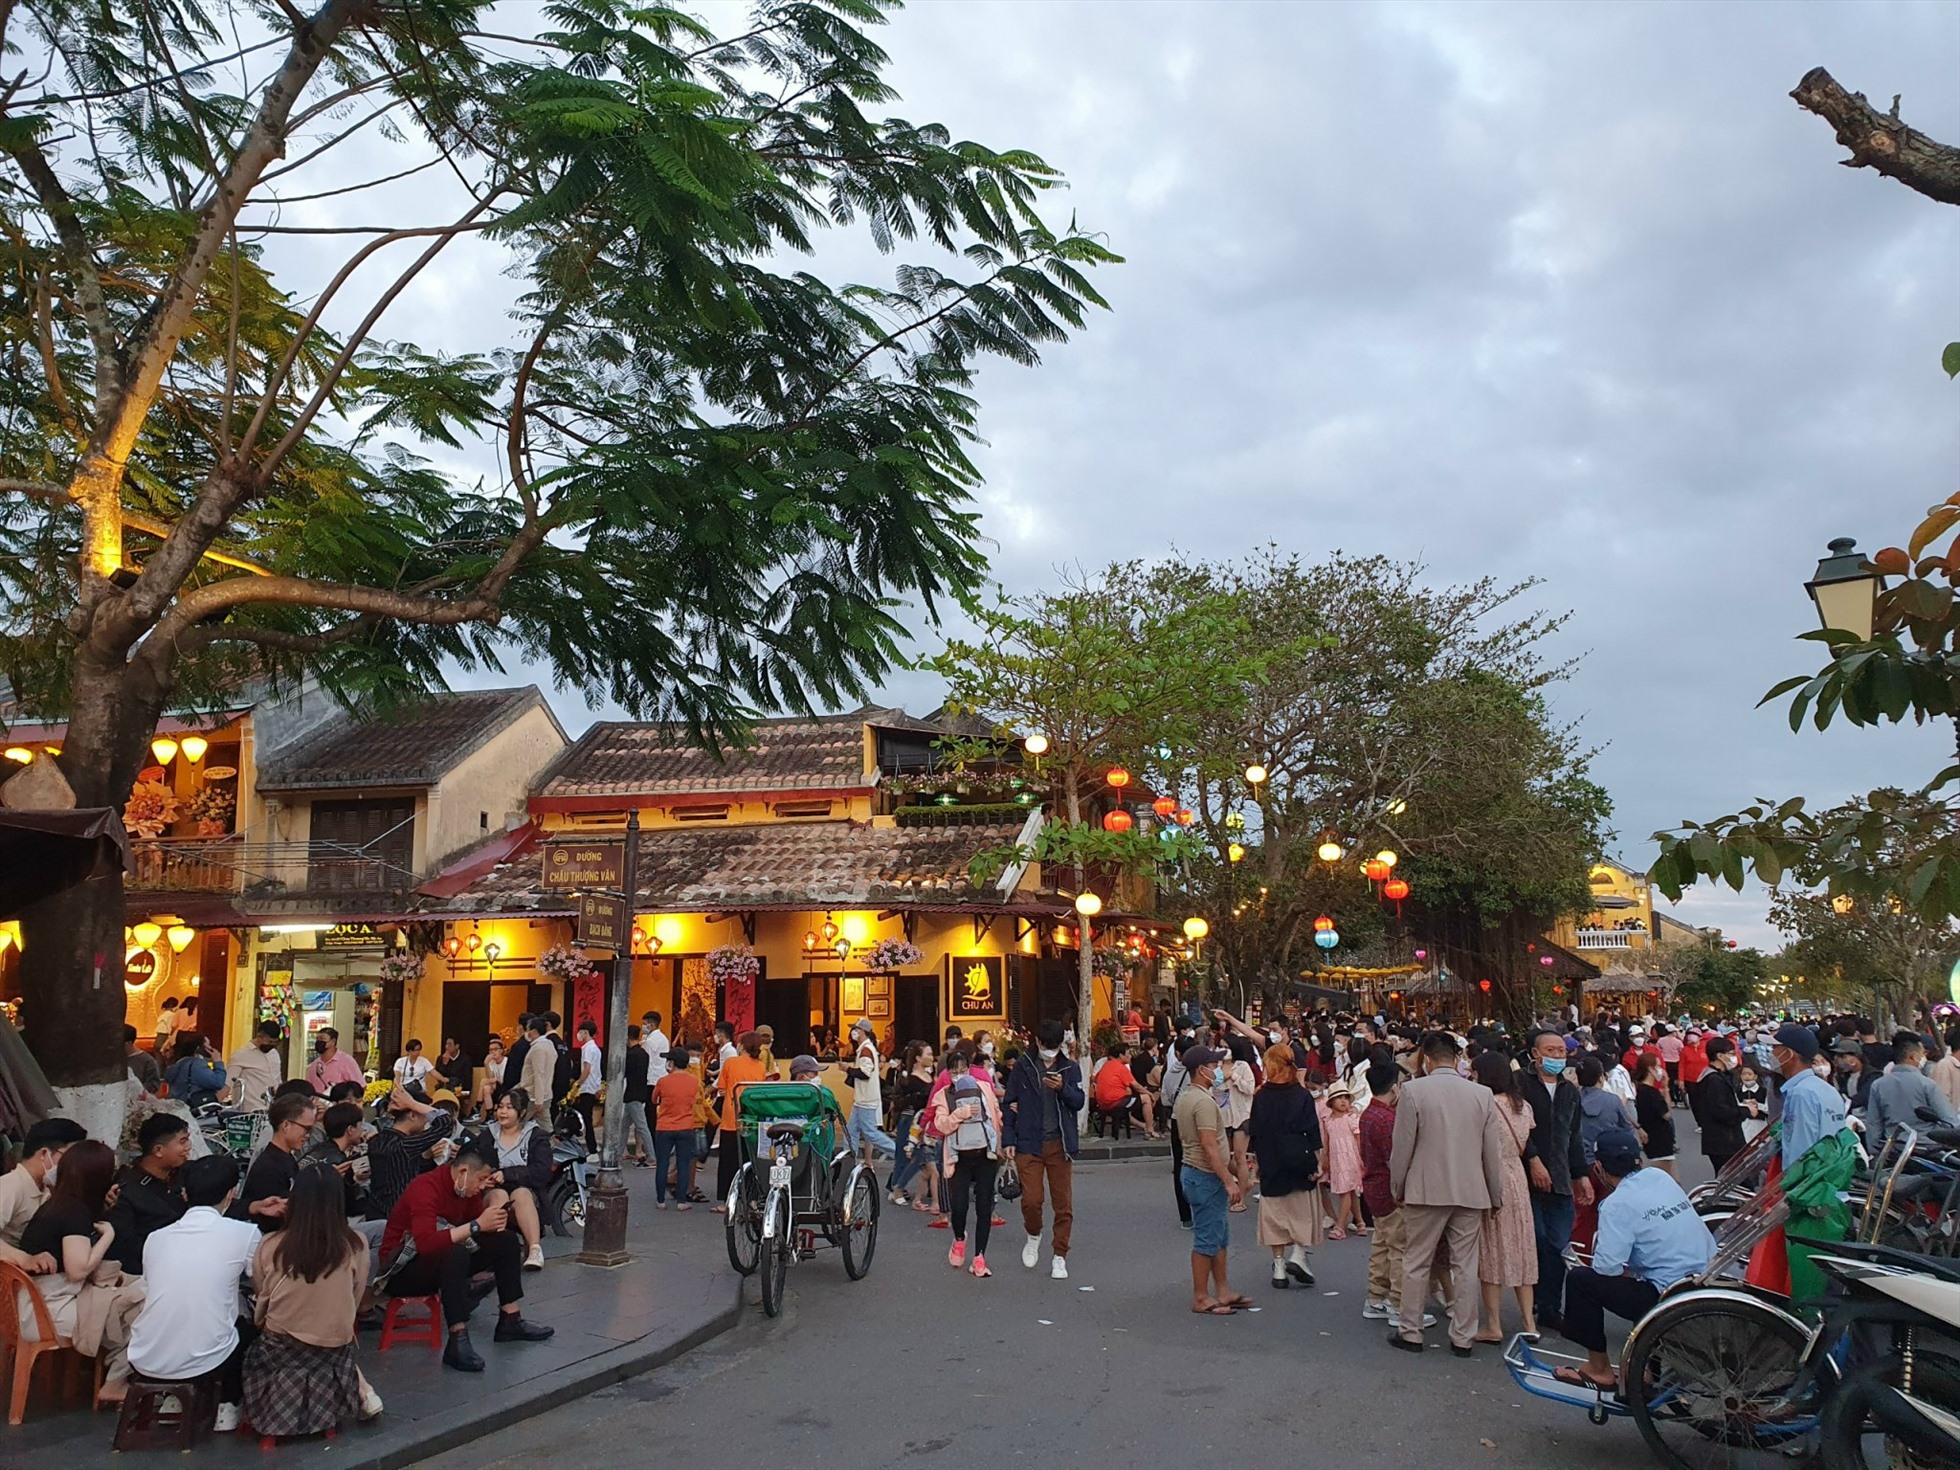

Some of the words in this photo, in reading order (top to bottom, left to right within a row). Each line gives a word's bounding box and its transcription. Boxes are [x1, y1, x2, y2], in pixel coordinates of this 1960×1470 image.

[576, 850, 602, 861] ĐƯỜNG
[571, 869, 599, 884] THƯỢNG
[962, 1001, 979, 1010] CHU
[982, 1001, 994, 1010] AN
[772, 1168, 789, 1179] 037
